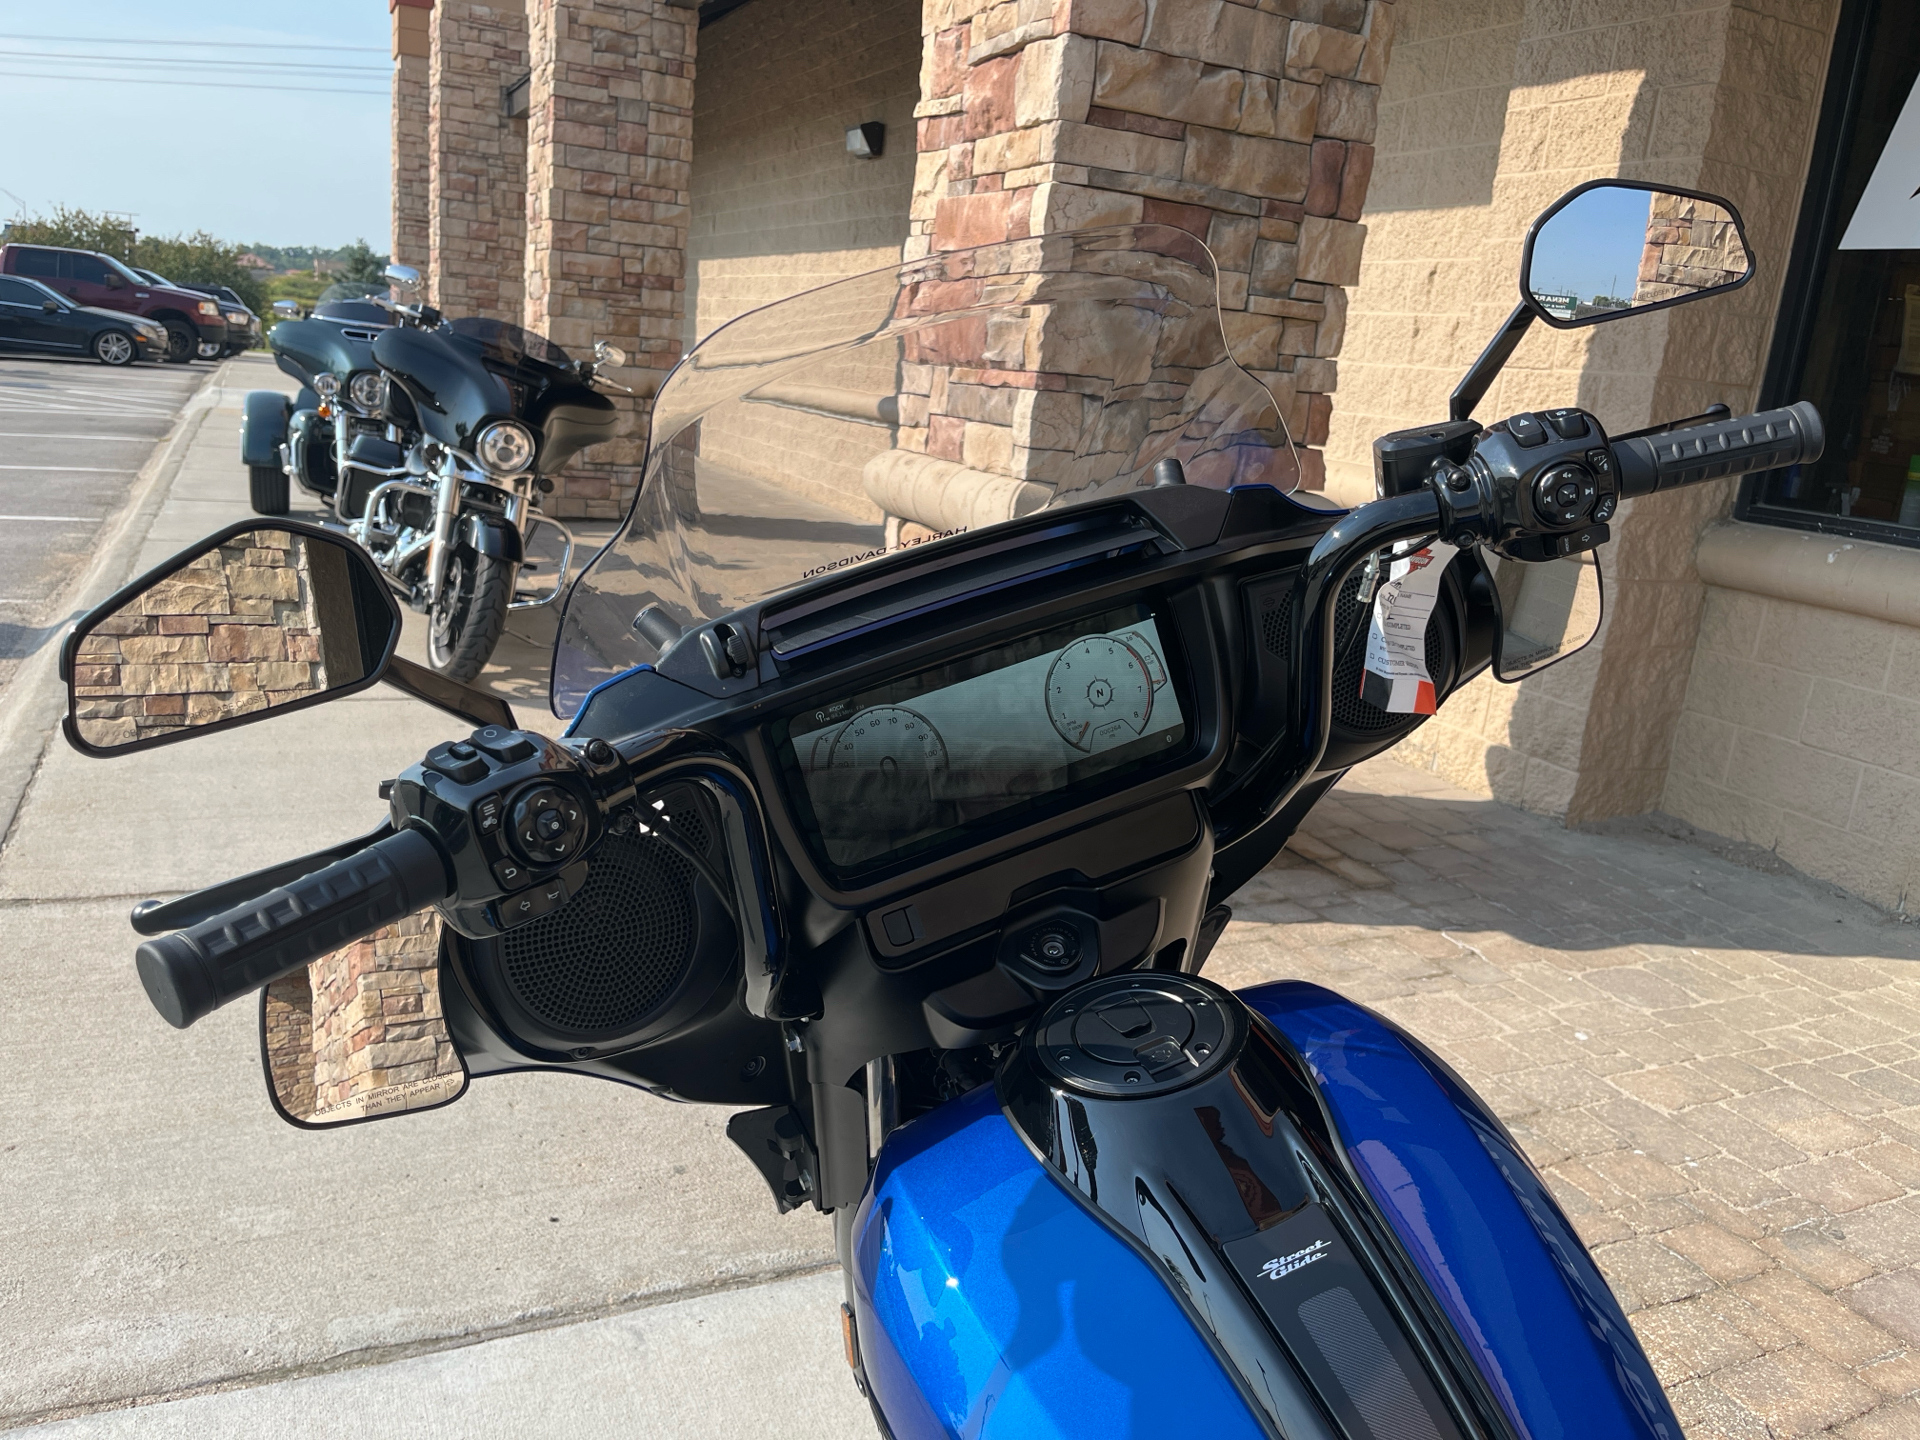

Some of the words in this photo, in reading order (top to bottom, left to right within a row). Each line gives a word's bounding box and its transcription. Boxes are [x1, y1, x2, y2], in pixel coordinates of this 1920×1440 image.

[1593, 454, 1606, 462] PTT
[1566, 634, 1585, 644] CLOSER
[1378, 656, 1405, 666] CUSTOMER
[1096, 688, 1104, 698] N
[870, 719, 881, 727] 60
[888, 717, 898, 725] 70
[905, 722, 915, 730] 80
[855, 728, 865, 737] 50
[918, 733, 929, 742] 90
[924, 749, 938, 758] 100
[314, 1100, 352, 1117] OBJECTS
[355, 1096, 364, 1105] IN
[368, 1086, 400, 1100] MIRROR
[402, 1081, 419, 1091] ARE
[422, 1071, 454, 1085] CLOSER
[360, 1101, 383, 1112] THAN
[386, 1094, 407, 1105] THEY
[410, 1083, 441, 1098] APPEAR
[1260, 1239, 1327, 1274] Street
[1270, 1252, 1325, 1280] Glide
